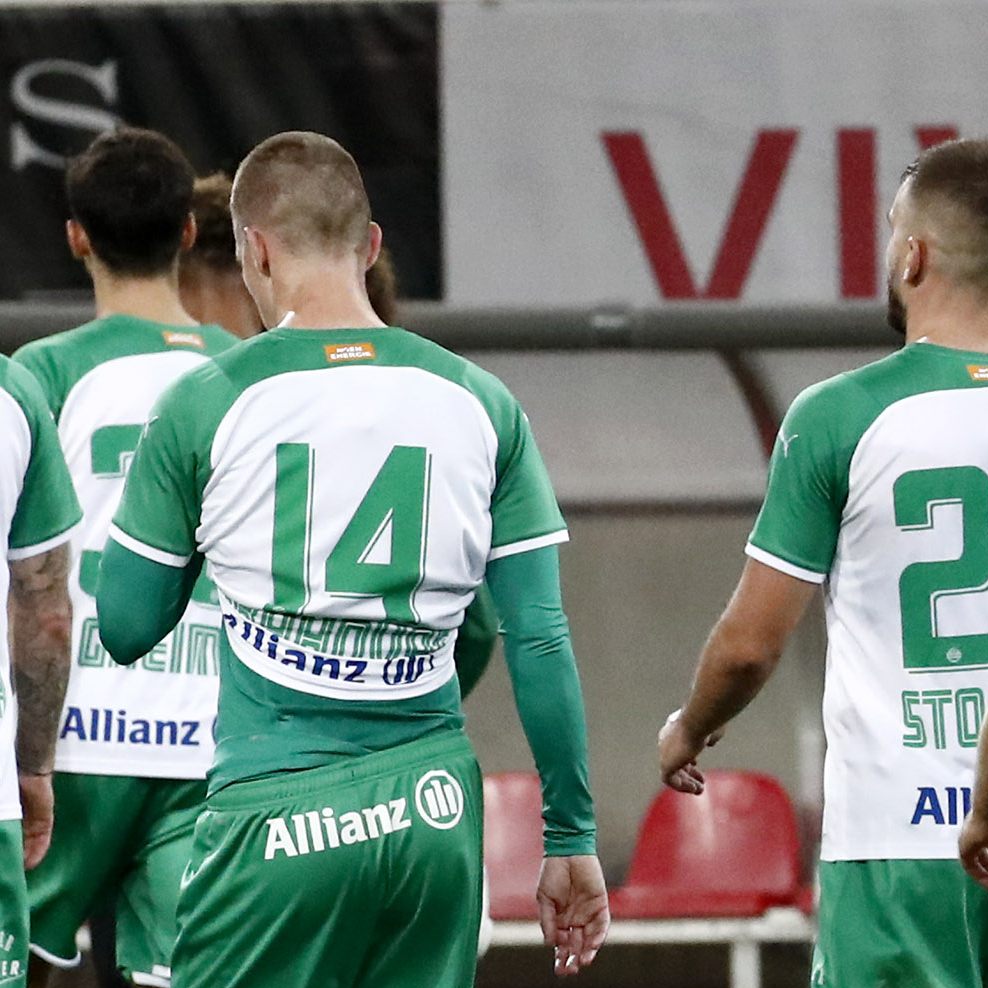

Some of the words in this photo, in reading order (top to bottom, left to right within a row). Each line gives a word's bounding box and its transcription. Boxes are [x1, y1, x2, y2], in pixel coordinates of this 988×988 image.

[271, 443, 432, 623] 14
[60, 706, 200, 746] Allianz
[264, 797, 412, 860] Allianz
